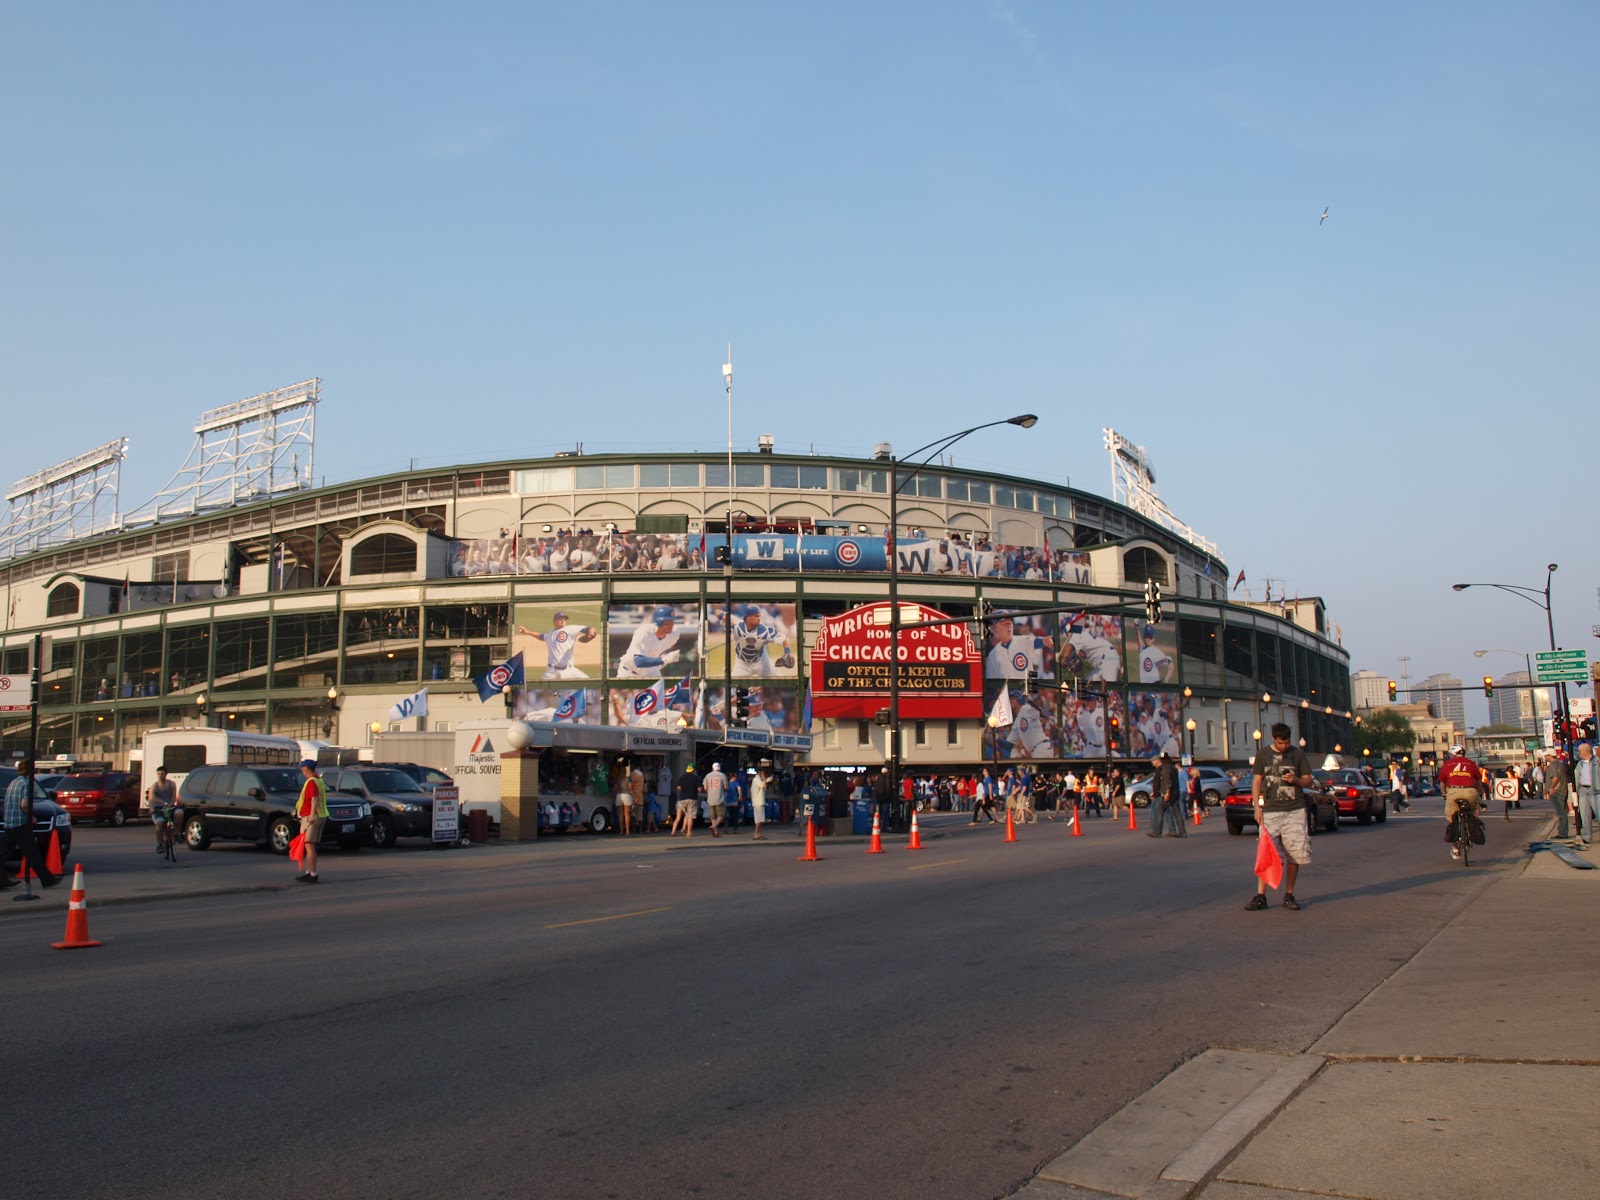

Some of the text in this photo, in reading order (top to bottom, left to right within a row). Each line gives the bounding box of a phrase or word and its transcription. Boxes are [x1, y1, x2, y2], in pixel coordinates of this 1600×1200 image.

[867, 630, 927, 640] HOME OF
[829, 644, 964, 661] CHICAGO CUBS
[847, 666, 946, 676] OFFICIL KEFIR
[828, 678, 965, 688] OF THE CHCAGO CUBS
[470, 754, 495, 764] Majestic
[455, 765, 501, 774] OFFICIAL SOUVE
[710, 779, 720, 788] 12
